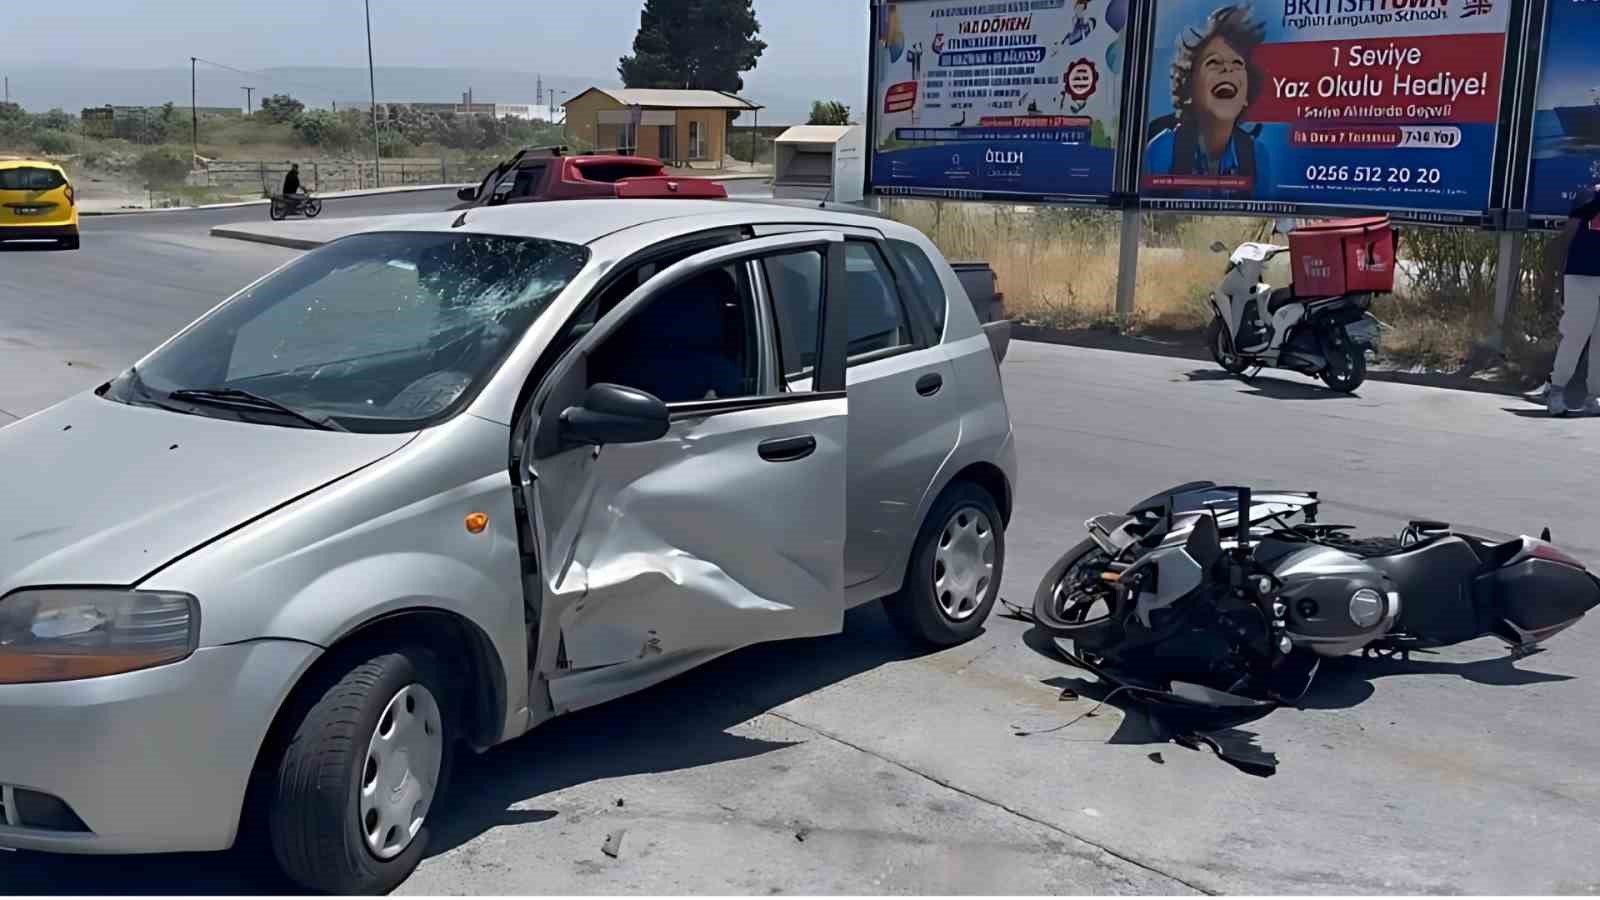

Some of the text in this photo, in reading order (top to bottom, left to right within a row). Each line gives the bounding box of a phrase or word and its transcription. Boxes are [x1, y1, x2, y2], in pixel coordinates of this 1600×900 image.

[1332, 43, 1421, 71] 1 Seviye
[1273, 71, 1488, 101] Yaz Okulu Hediye!
[1306, 165, 1441, 184] 0256 512 20 20
